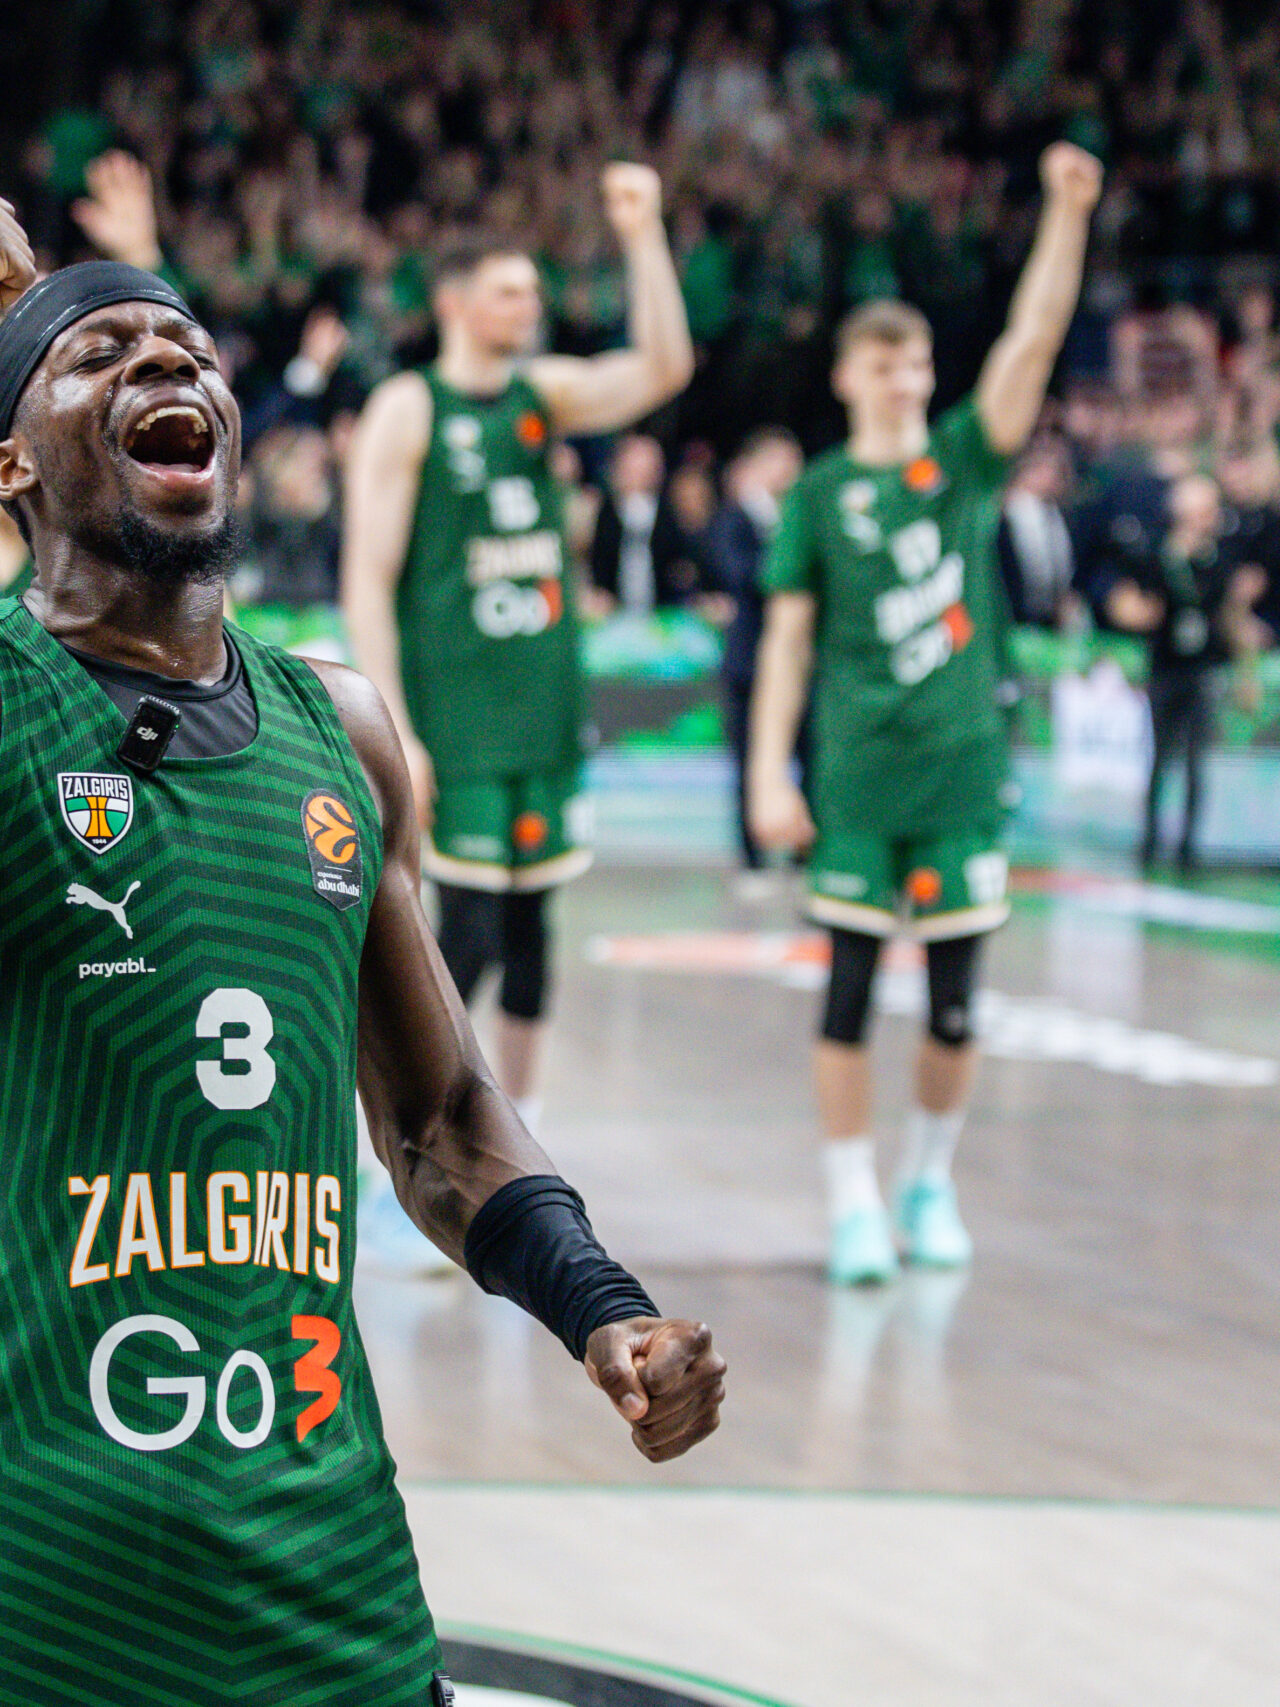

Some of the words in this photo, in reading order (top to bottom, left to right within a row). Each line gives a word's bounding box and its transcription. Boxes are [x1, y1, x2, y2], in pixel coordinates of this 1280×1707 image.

[136, 726, 159, 741] dji
[318, 879, 337, 892] abu
[336, 881, 360, 897] dhabi
[195, 987, 276, 1110] 3
[88, 1313, 342, 1451] Go3
